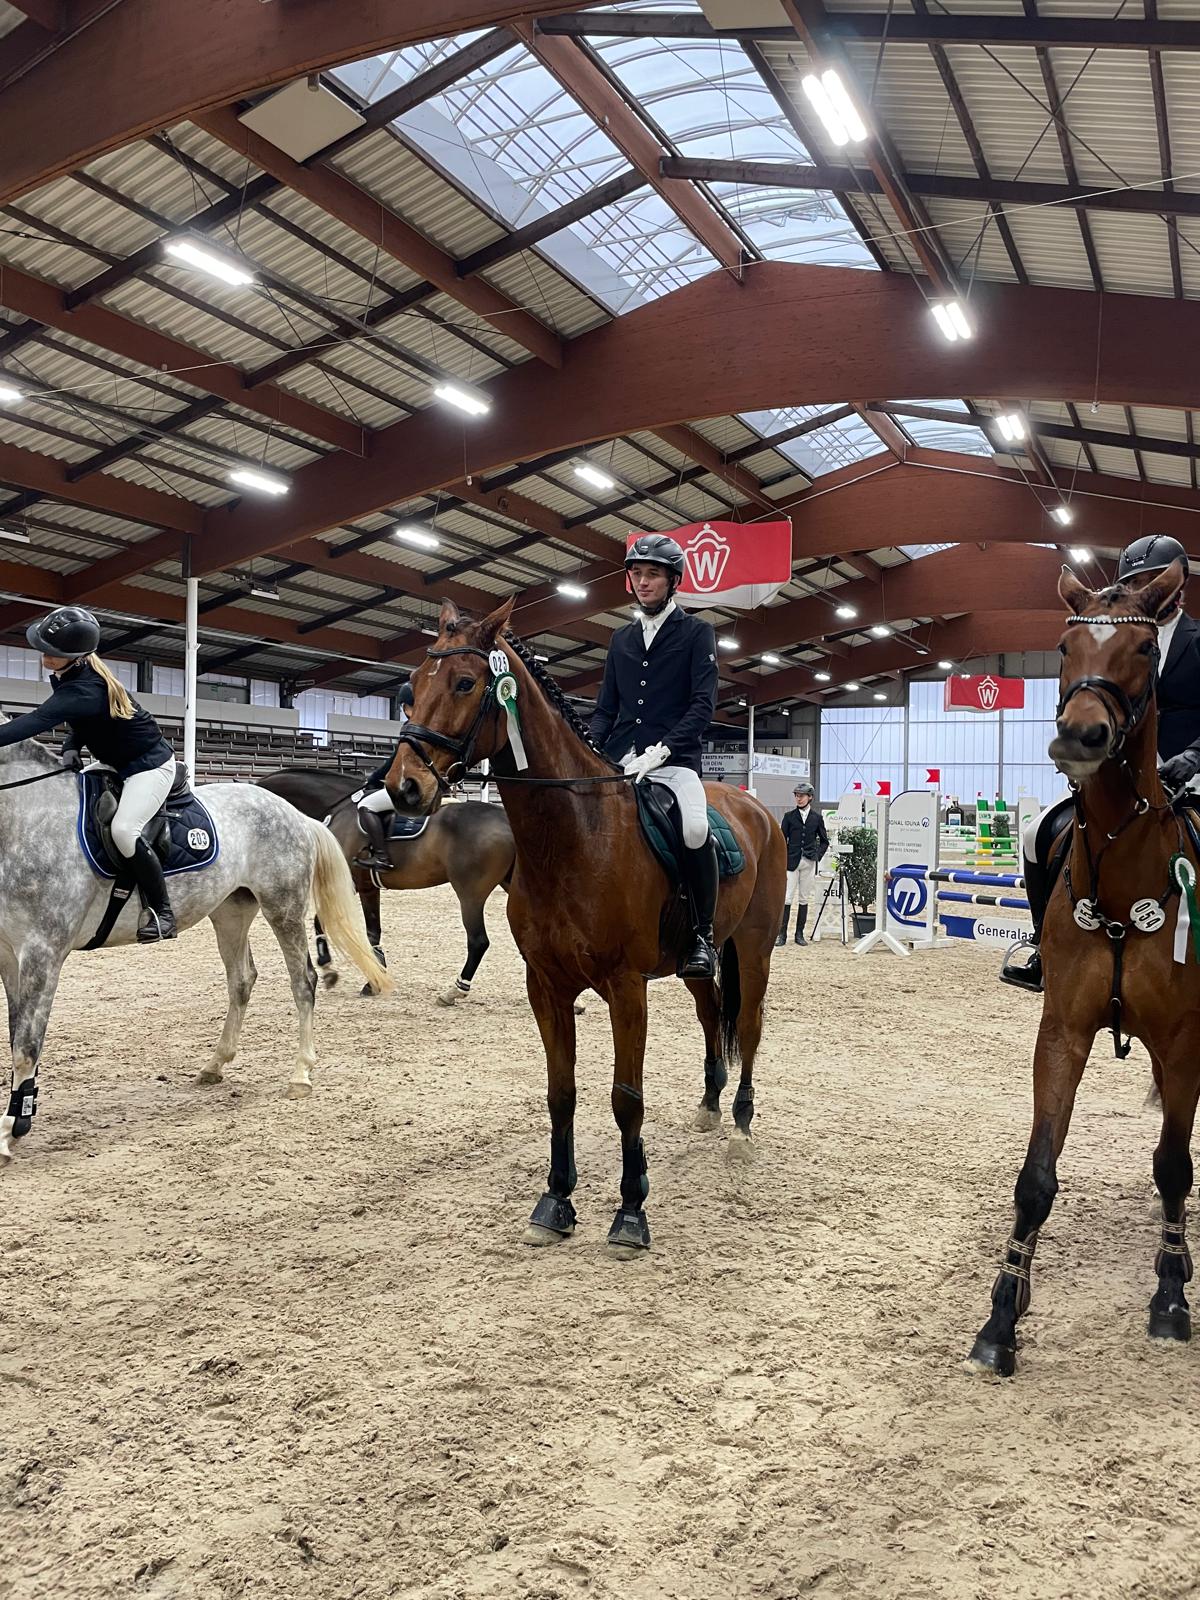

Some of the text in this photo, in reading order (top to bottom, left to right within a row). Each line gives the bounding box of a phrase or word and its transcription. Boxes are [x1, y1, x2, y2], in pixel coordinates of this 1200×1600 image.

[693, 551, 720, 581] W
[492, 655, 508, 673] 025
[982, 688, 995, 704] W
[191, 832, 208, 846] 203
[1134, 901, 1162, 929] 054
[977, 923, 1035, 941] Generalag
